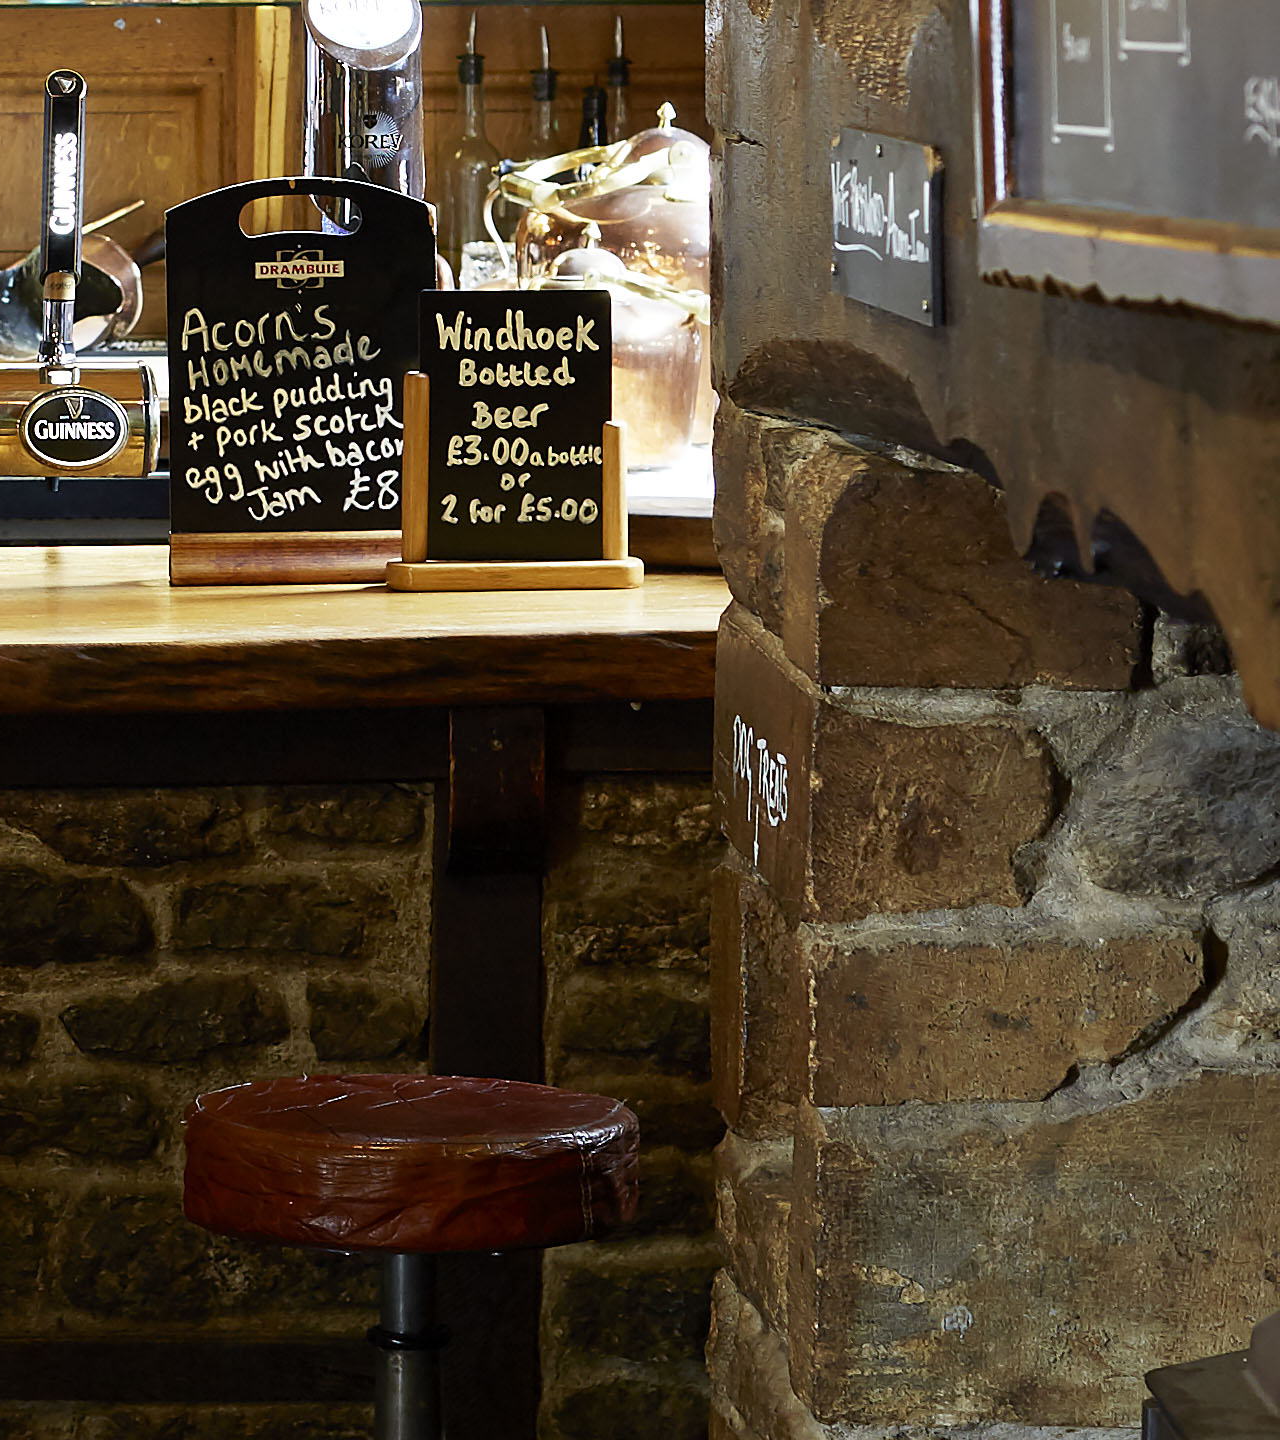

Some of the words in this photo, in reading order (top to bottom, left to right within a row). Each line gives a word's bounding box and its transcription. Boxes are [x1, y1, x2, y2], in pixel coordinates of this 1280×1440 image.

[336, 131, 402, 153] KOREV
[48, 131, 79, 236] GUINNESS
[258, 260, 342, 276] DRAMBUIE
[181, 302, 337, 353] Acorn's
[435, 307, 601, 353] Windhoek
[187, 329, 382, 393] Homemade
[458, 355, 576, 389] Bottled
[183, 386, 264, 425] black
[273, 370, 394, 419] pudding
[33, 418, 117, 440] GUINNESS
[471, 400, 551, 430] Beer
[187, 431, 204, 453] +
[446, 434, 531, 468] £3.00
[529, 451, 546, 467] a
[545, 443, 604, 467] bottle
[185, 461, 245, 505] egg
[255, 441, 325, 484] with
[499, 470, 532, 491] or
[247, 483, 322, 522] Jam
[342, 466, 401, 513] £8
[439, 494, 459, 525] 2
[469, 494, 508, 525] for
[516, 495, 600, 526] £5.00
[732, 713, 754, 823] DOG
[756, 737, 789, 828] TREATS
